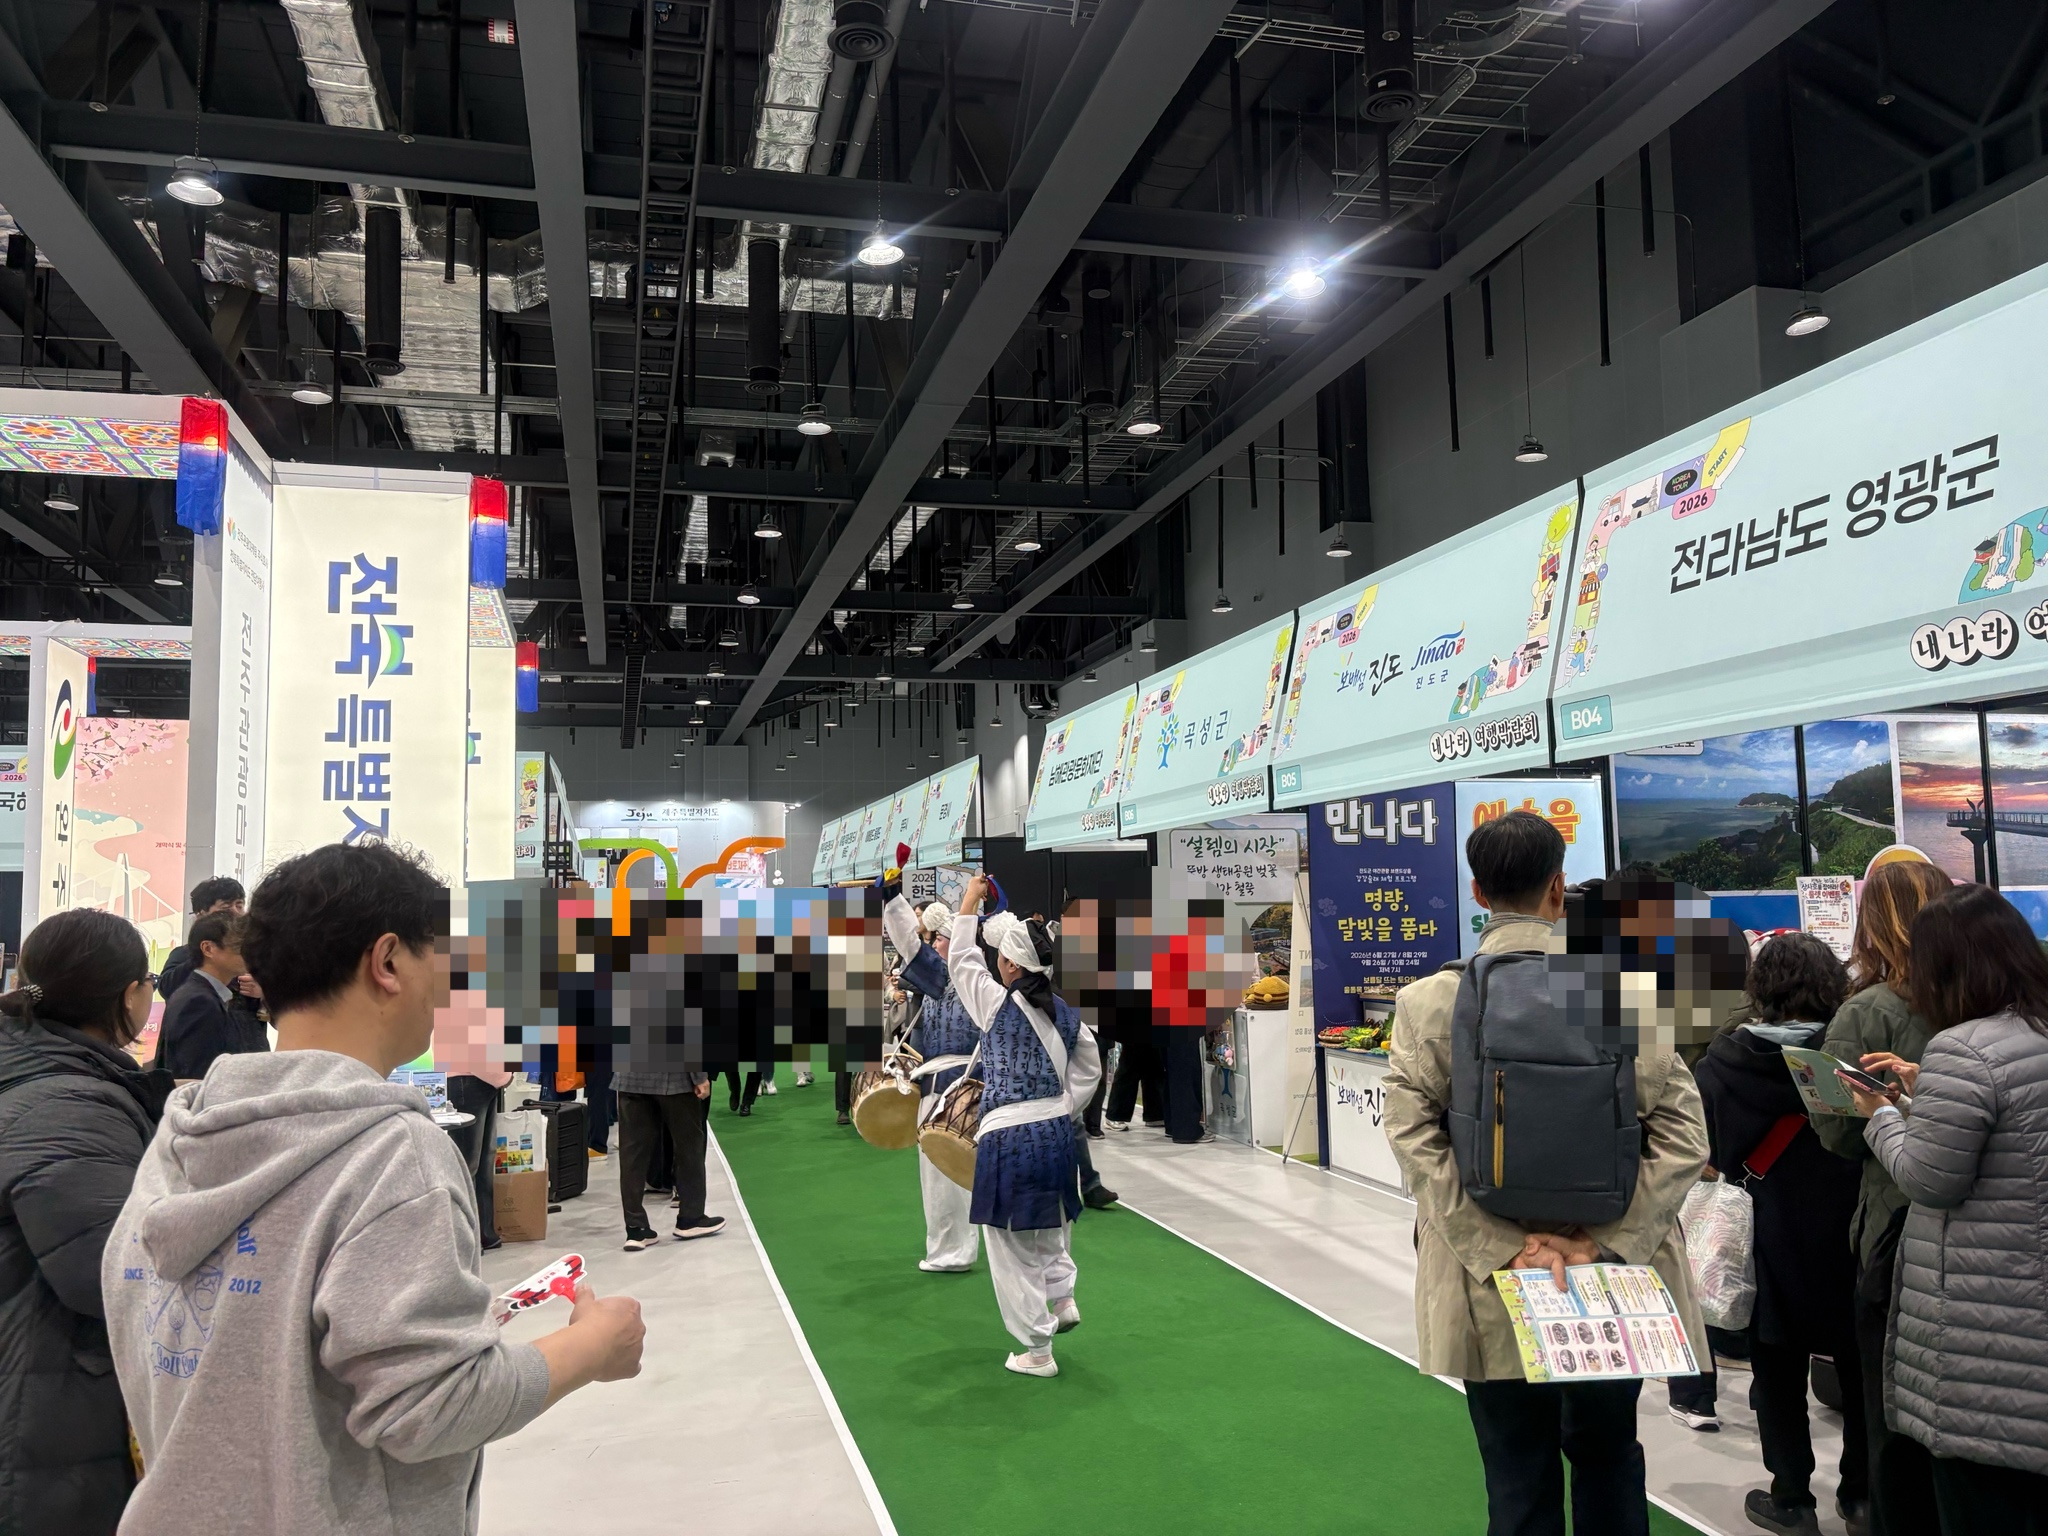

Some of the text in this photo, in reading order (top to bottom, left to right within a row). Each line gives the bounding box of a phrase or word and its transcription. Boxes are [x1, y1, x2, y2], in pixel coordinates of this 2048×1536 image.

[1707, 448, 1728, 477] START
[1671, 472, 1691, 485] KOREA
[1672, 481, 1689, 493] TOUR
[1670, 434, 2000, 594] 전라남도 영광군
[1679, 492, 1708, 515] 2026
[1342, 630, 1357, 645] 2026
[1915, 617, 2009, 661] 내나라
[1411, 641, 1456, 671] Jindo
[1337, 652, 1404, 697] 보배섬 진도
[1415, 669, 1449, 690] 진도군
[1184, 710, 1229, 750] 곡성군
[1570, 707, 1603, 730] B04
[1430, 713, 1540, 756] 내나라 여행박람회
[1048, 750, 1104, 787] 남해관광문화재단
[1281, 771, 1297, 786] B05
[626, 807, 719, 821] Jeju 제주특별자치도
[1124, 810, 1134, 821] B06
[1326, 799, 1438, 845] 만나다
[53, 801, 70, 908] 완주
[1180, 834, 1285, 858] “설렘의 시작”
[912, 873, 936, 882] 2026
[1211, 864, 1253, 879] 생태공원
[1355, 874, 1380, 884] 강강술래
[1394, 874, 1417, 883] 프로그램
[1364, 888, 1409, 912] 명량,
[1337, 917, 1438, 942] 달빛을 품다
[1350, 951, 1372, 959] 2026년
[1372, 951, 1382, 959] 6월
[1383, 951, 1397, 959] 27일
[1402, 951, 1413, 959] 8월
[1363, 976, 1383, 984] 보름달
[1383, 976, 1397, 984] 뜨는
[1337, 1085, 1387, 1127] 보배섬 진
[236, 1212, 258, 1257] olf
[124, 1268, 144, 1281] SINCE
[228, 1278, 262, 1295] 2012
